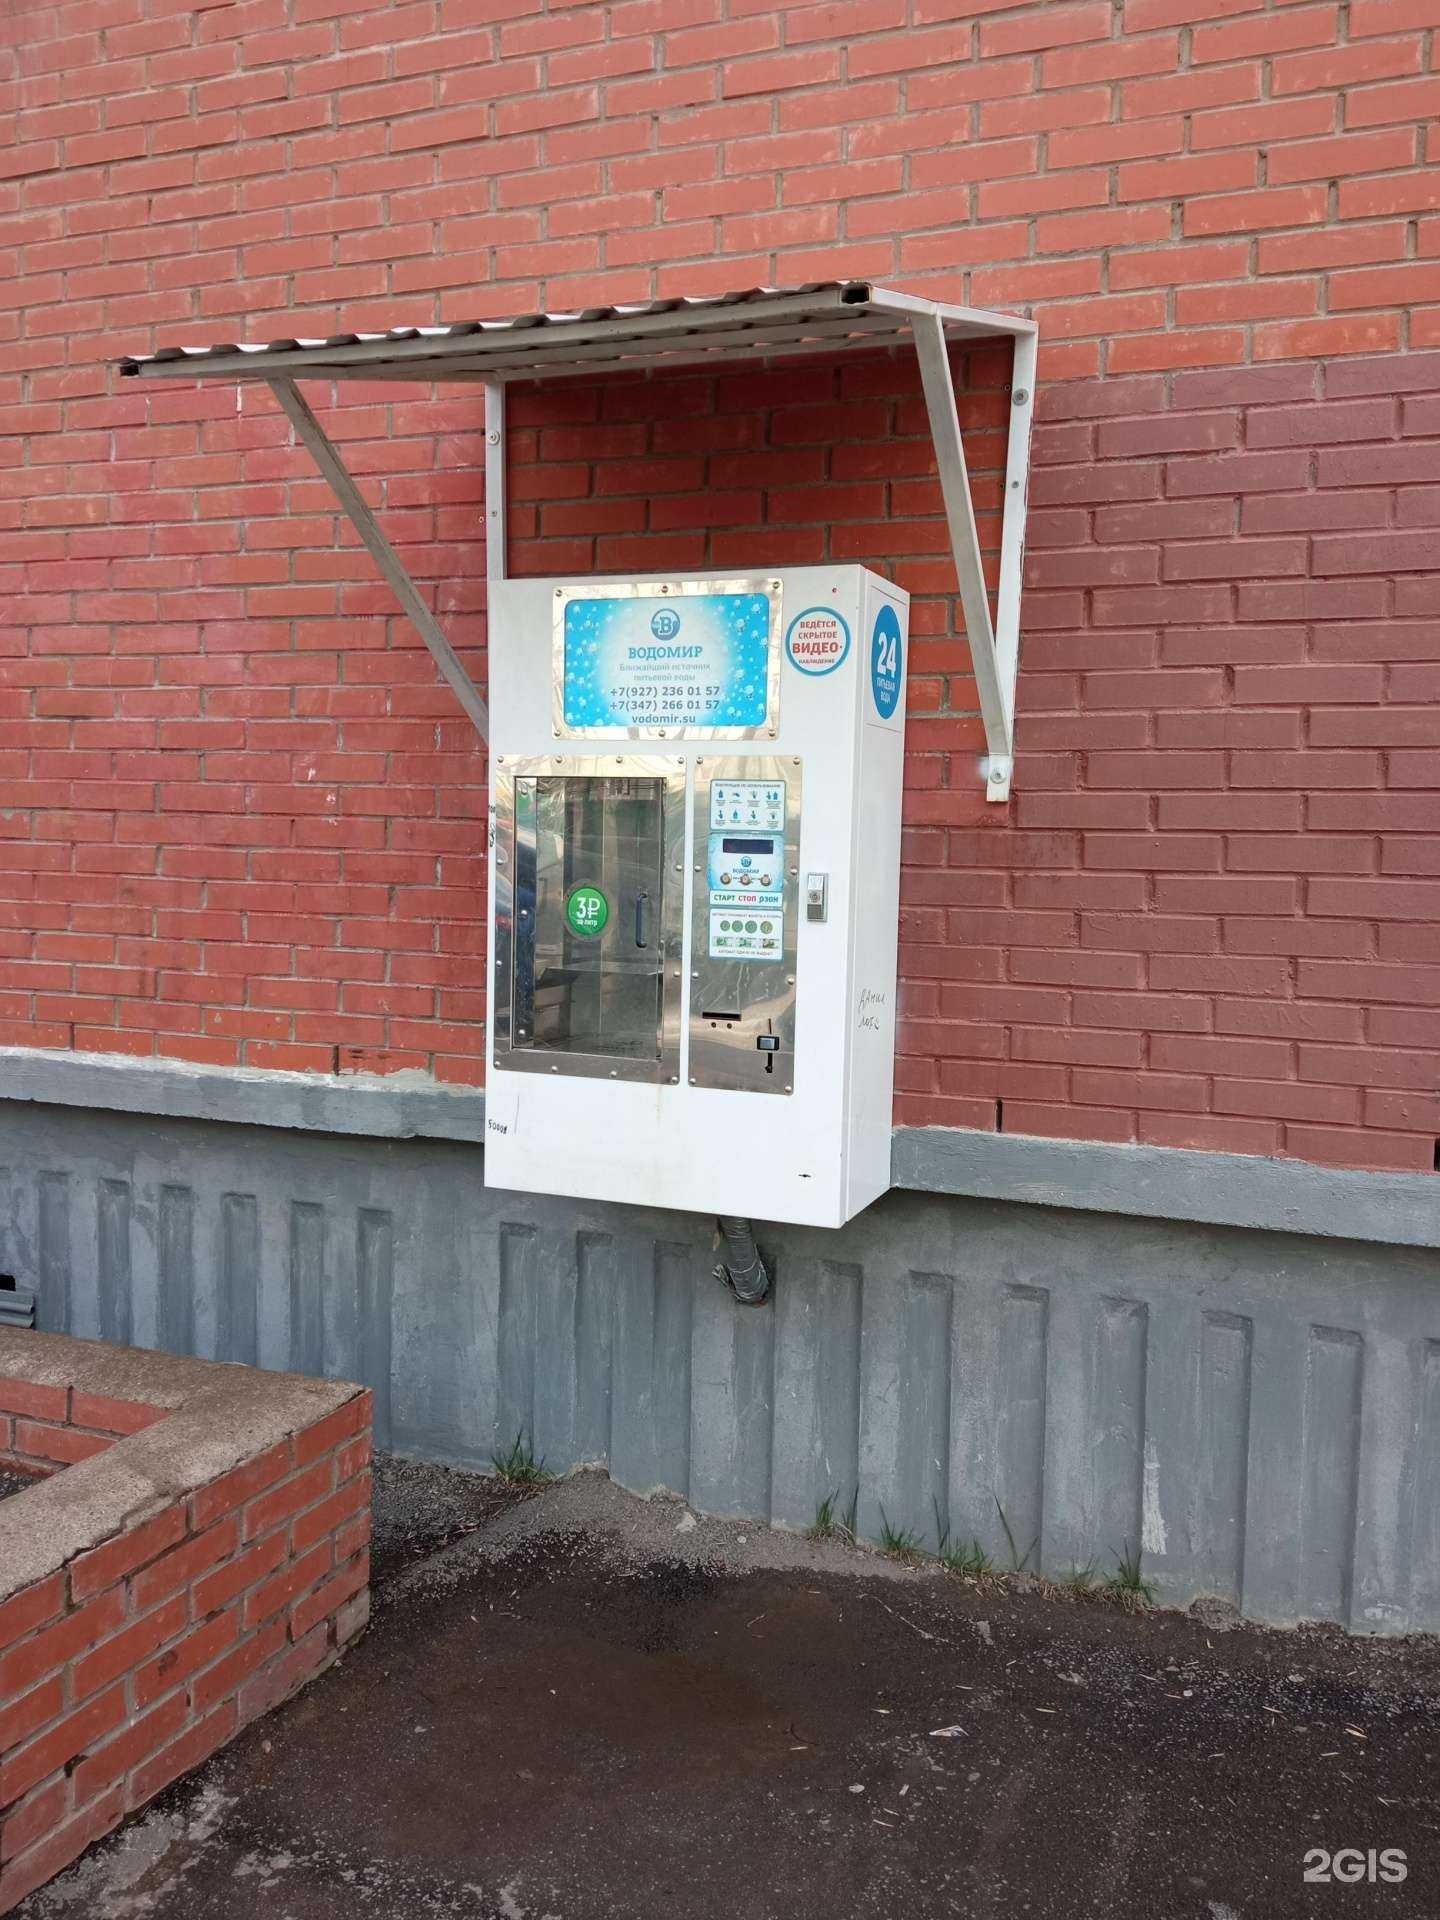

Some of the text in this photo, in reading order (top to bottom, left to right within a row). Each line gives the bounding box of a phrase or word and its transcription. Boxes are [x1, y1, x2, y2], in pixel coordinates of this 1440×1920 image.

[798, 631, 838, 640] СКРЫТОЕ
[628, 645, 704, 661] ВОДОМИР
[876, 631, 898, 679] 24
[610, 685, 720, 699] +7(927) 236 01 57
[609, 699, 720, 712] +7(347) 266 01 57
[631, 714, 696, 724] vodomir.su
[713, 894, 736, 902] СТАРТ
